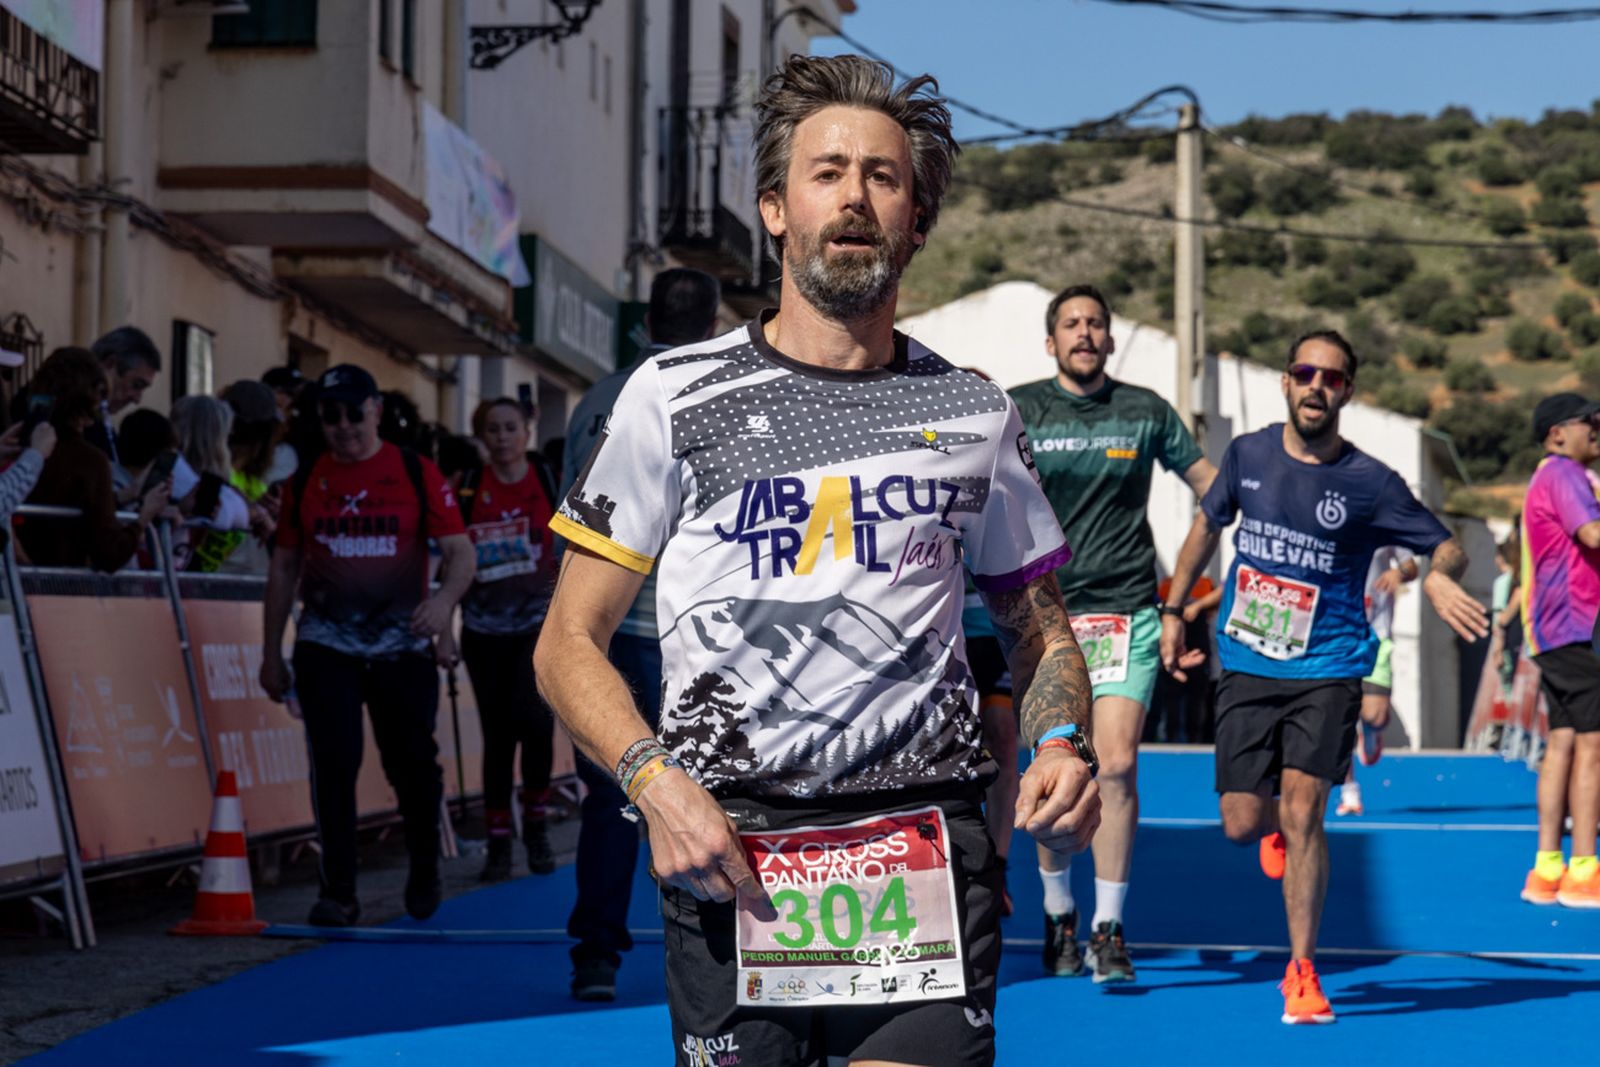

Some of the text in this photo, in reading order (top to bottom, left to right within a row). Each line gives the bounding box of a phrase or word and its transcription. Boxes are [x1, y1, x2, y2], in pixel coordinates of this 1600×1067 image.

[714, 475, 960, 542] JABALCUZ
[738, 522, 892, 580] TRAIL
[1238, 530, 1334, 574] BULEVAR
[1244, 598, 1292, 634] 431
[1082, 637, 1114, 665] 28
[757, 838, 792, 869] X
[799, 831, 909, 866] CROSS
[760, 860, 912, 892] PANTANO DEL
[772, 876, 917, 949] 304
[741, 951, 784, 963] PEDRO
[787, 950, 838, 962] MANUEL
